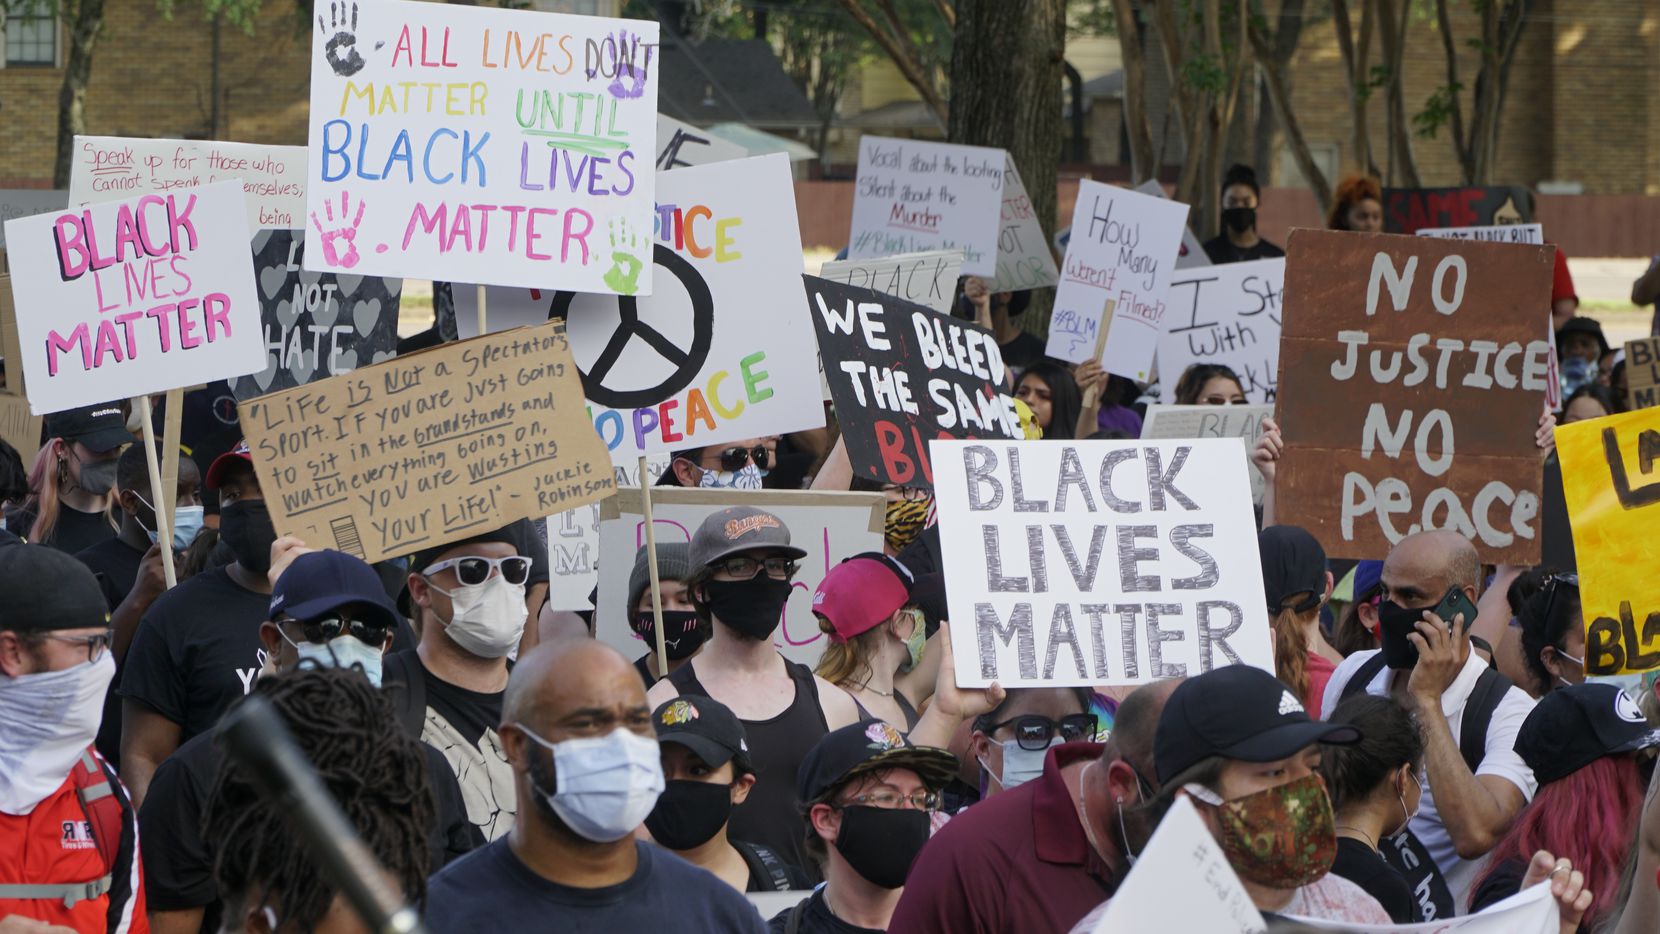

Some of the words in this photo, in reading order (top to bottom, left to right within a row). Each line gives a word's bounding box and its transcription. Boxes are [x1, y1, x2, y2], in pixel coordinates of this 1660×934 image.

[392, 24, 458, 68] ALL
[482, 29, 573, 75] LIVES
[340, 81, 489, 117] MATTER
[515, 88, 629, 137] UNTIL
[84, 143, 135, 171] Speak
[144, 154, 163, 176] up
[172, 147, 197, 170] for
[206, 150, 248, 170] those
[252, 154, 285, 175] who
[321, 119, 491, 188] BLACK
[519, 141, 635, 197] LIVES
[868, 145, 902, 170] Vocal
[909, 152, 937, 173] about
[944, 155, 958, 175] the
[963, 155, 1001, 191] looting
[243, 181, 304, 197] emselves;
[859, 175, 895, 198] Silent
[900, 183, 932, 203] about
[939, 185, 957, 205] the
[889, 202, 942, 227] Murder
[53, 194, 199, 281] BLACK
[259, 206, 292, 227] being
[401, 202, 594, 266] MATTER
[655, 204, 743, 263] TICE
[998, 225, 1023, 254] OT
[1089, 195, 1140, 248] How
[94, 255, 192, 313] LIVES
[1118, 247, 1158, 291] Many
[1365, 251, 1468, 316] NO
[291, 283, 338, 314] NOT
[1054, 310, 1096, 340] #BLM
[1117, 290, 1166, 324] Filmed?
[1169, 277, 1218, 333] I
[46, 293, 232, 376] MATTER
[264, 323, 354, 377] HATE
[815, 292, 891, 350] WE
[912, 312, 1005, 386] BLEED
[1187, 322, 1257, 357] With
[385, 365, 425, 393] Not
[435, 362, 452, 377] a
[417, 389, 454, 414] are
[632, 351, 774, 450] PEACE
[840, 361, 919, 415] THE
[927, 378, 1025, 440] SAME
[272, 467, 297, 489] to
[350, 443, 370, 462] in
[378, 434, 409, 453] the
[522, 392, 555, 411] and
[1361, 403, 1455, 477] NO
[352, 450, 446, 488] everything
[418, 467, 460, 492] are
[963, 445, 1201, 513] BLACK
[981, 523, 1220, 594] LIVES
[974, 599, 1244, 681] MATTER
